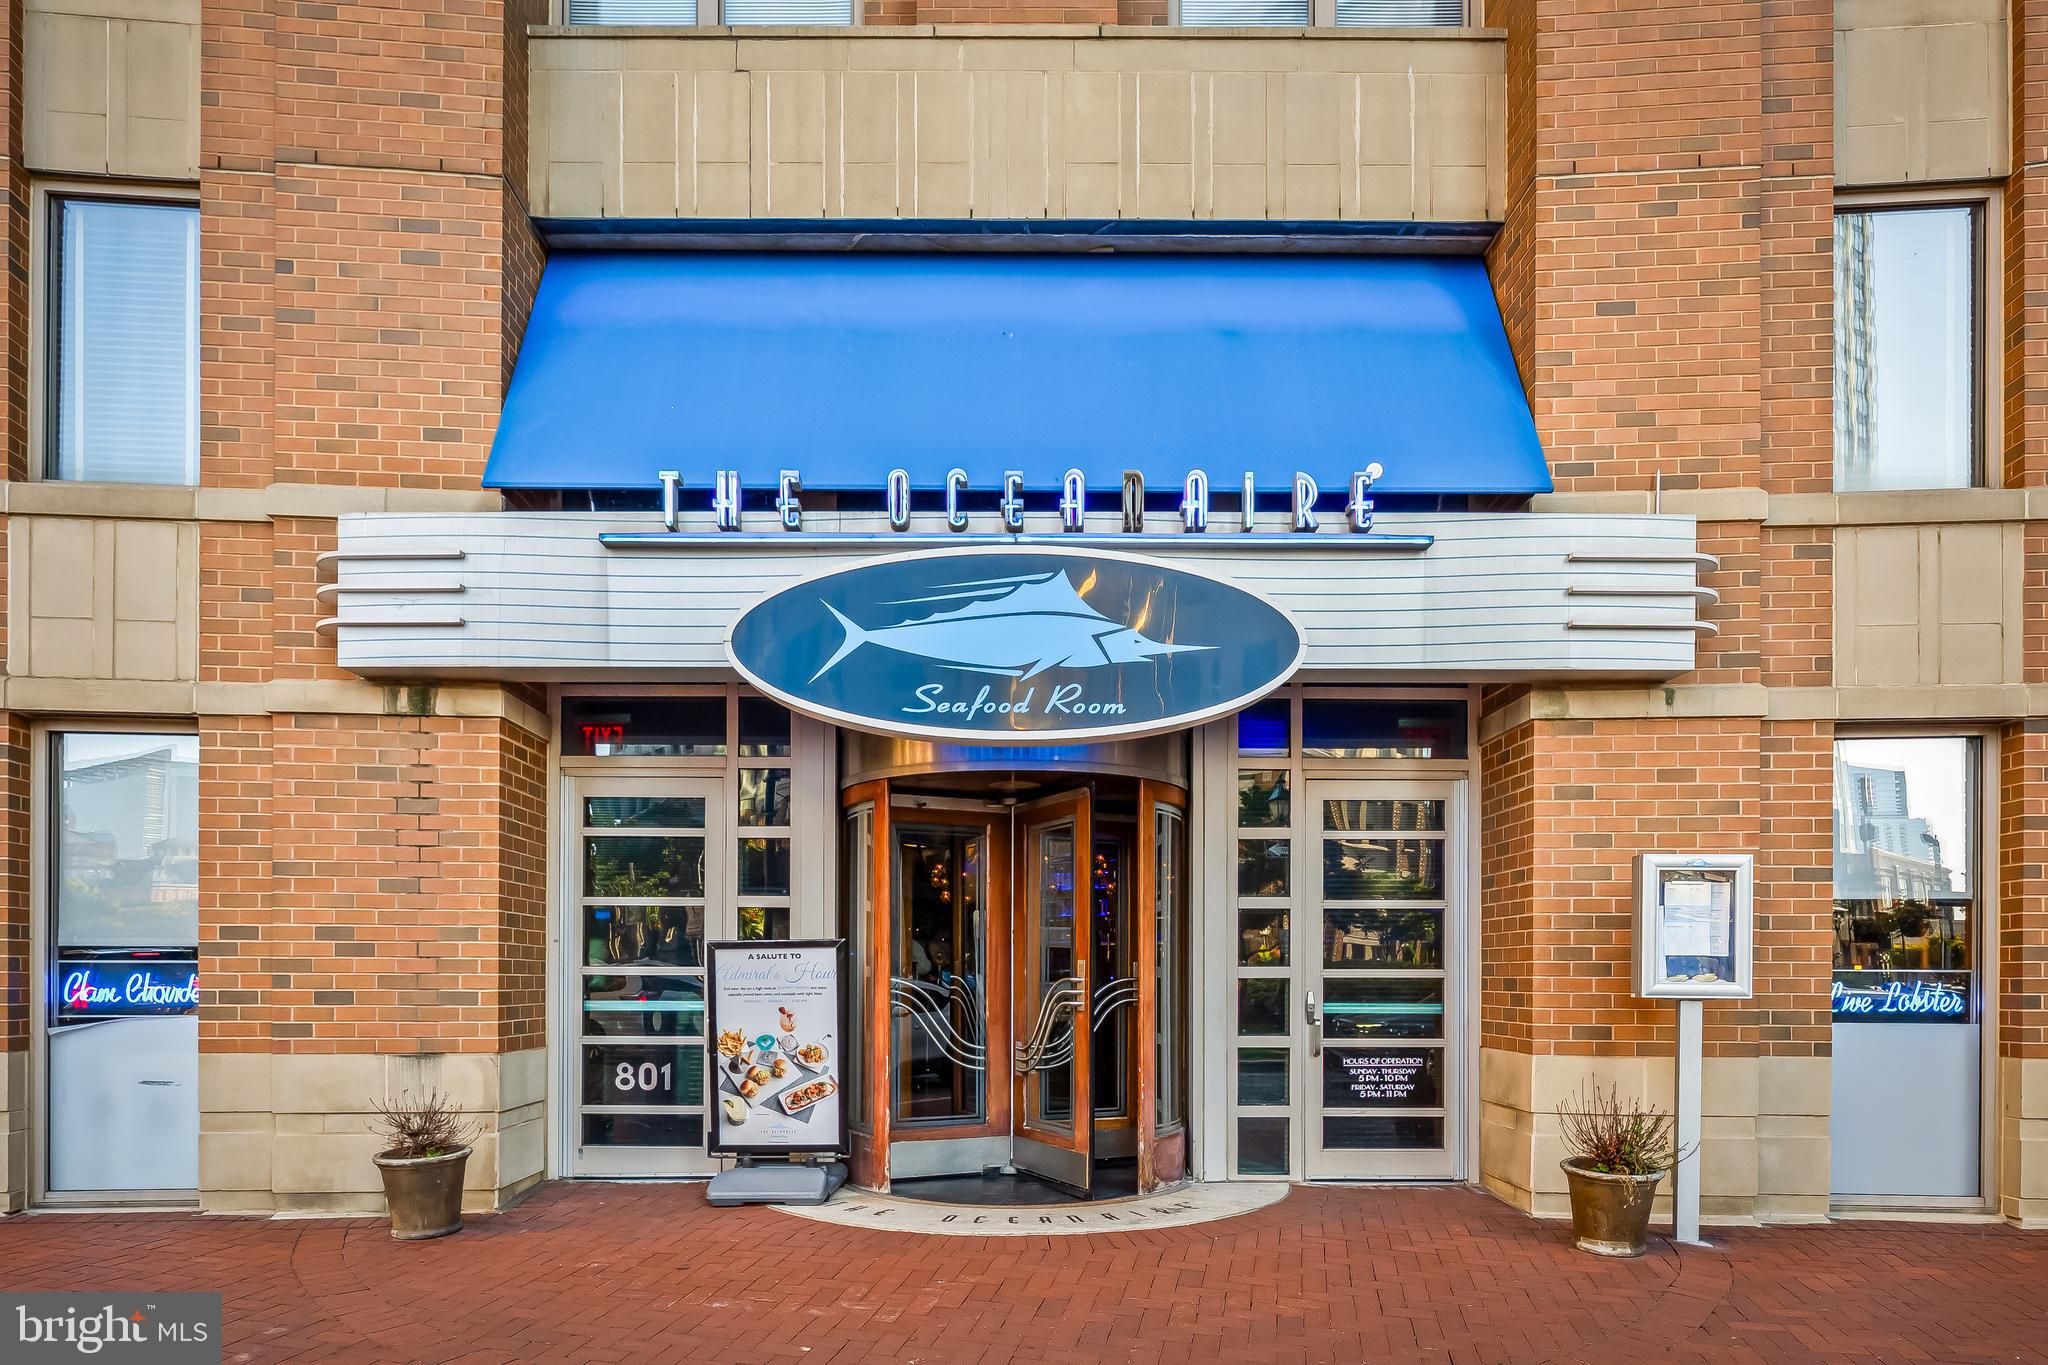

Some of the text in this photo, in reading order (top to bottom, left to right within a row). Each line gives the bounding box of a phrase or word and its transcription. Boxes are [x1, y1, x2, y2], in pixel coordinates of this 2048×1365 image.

[659, 467, 1374, 533] THE OCEANAIRE
[901, 683, 1127, 721] Seafood Room
[64, 971, 122, 1003] Clam
[1878, 980, 1965, 1013] Lobster
[615, 1062, 671, 1091] 801
